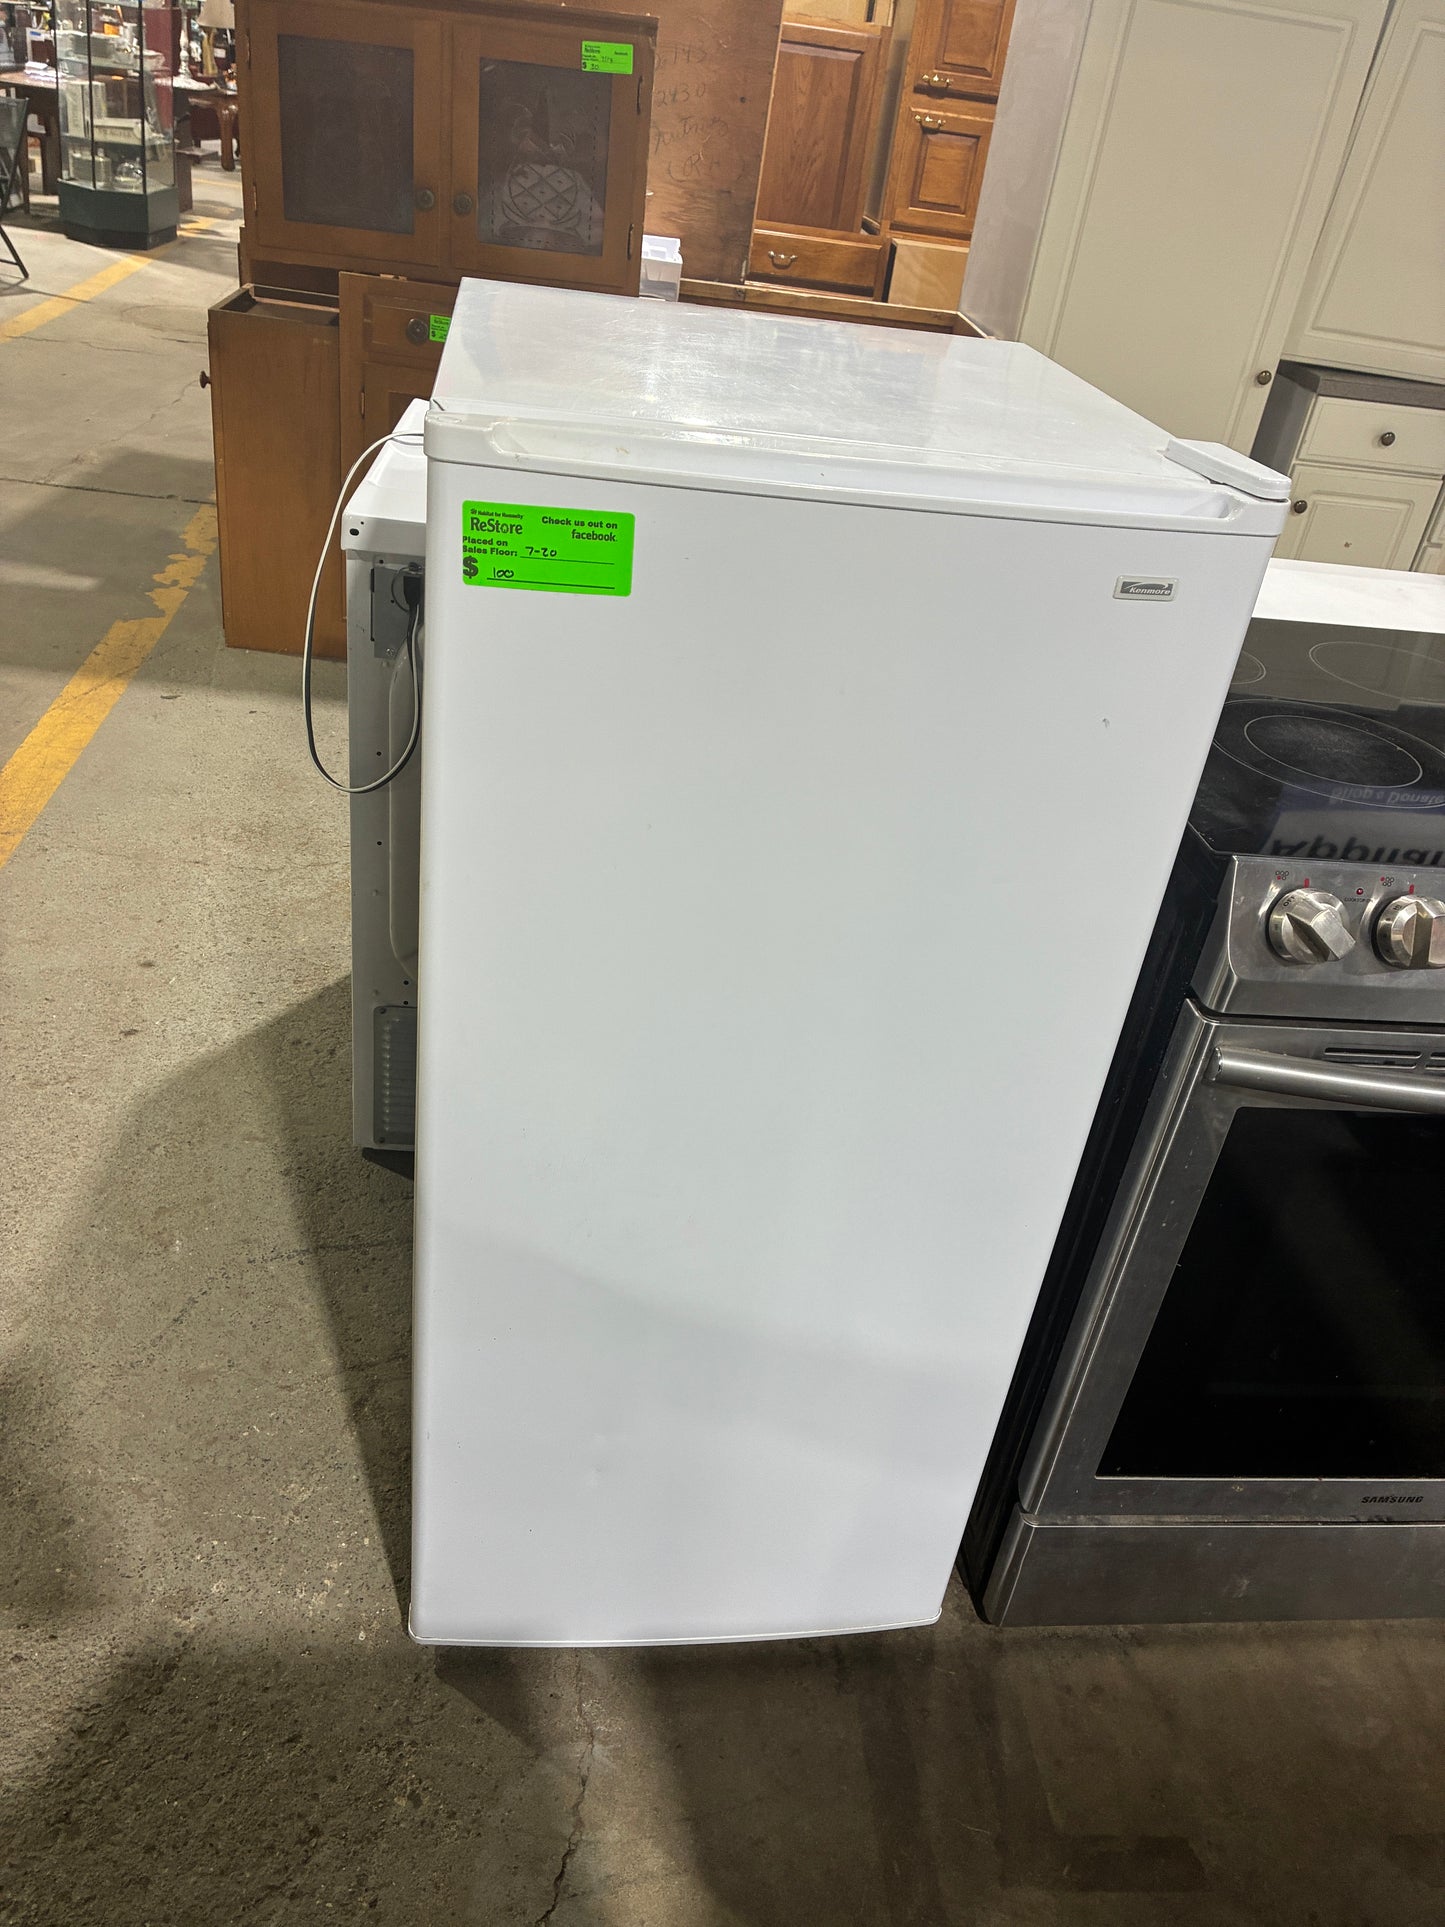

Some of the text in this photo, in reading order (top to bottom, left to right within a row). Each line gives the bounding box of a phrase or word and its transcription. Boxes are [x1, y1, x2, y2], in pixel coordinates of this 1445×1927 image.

[470, 516, 524, 535] ReStore
[541, 516, 619, 530] Check us out on
[462, 535, 509, 547] Placed on
[462, 544, 557, 558] Sales Floor: 7-20
[462, 555, 515, 580] $ 100
[1129, 586, 1172, 596] Kenmore
[1361, 1495, 1424, 1504] SAMSUNG
